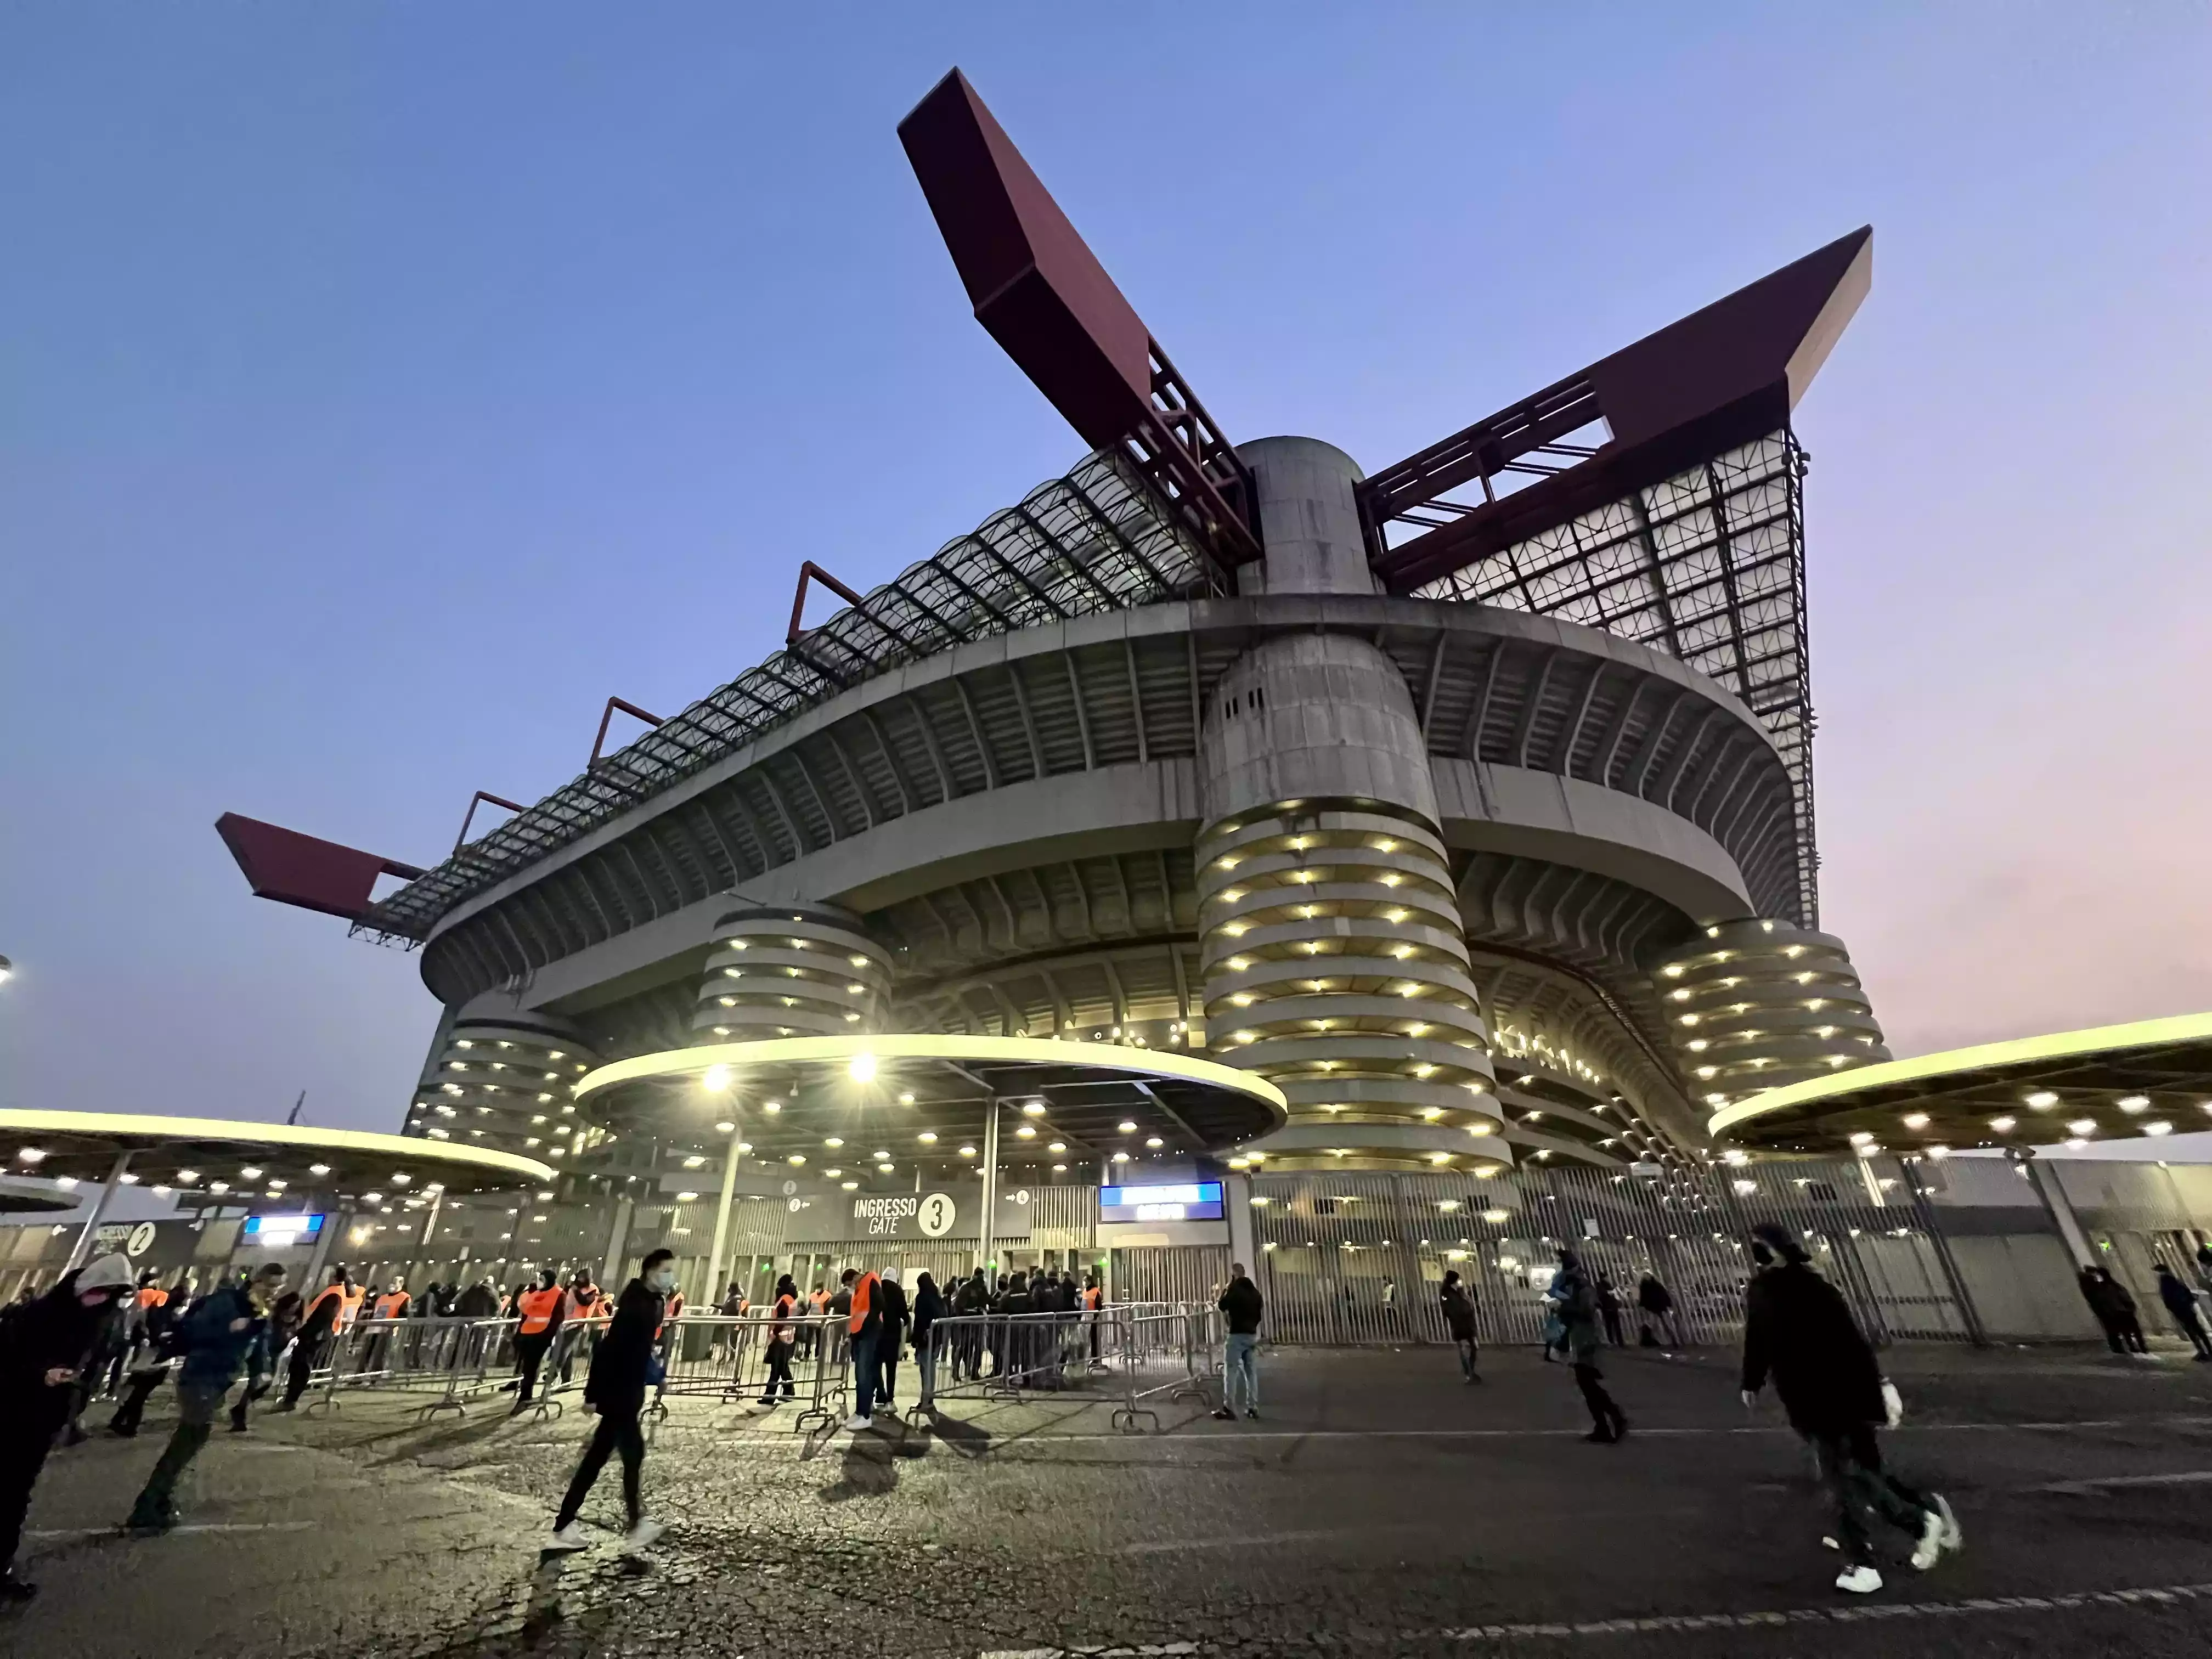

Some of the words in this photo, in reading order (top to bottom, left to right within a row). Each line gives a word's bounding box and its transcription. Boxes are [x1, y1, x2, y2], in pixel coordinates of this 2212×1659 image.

[854, 1198, 917, 1218] INGRESSO
[930, 1199, 943, 1230] 3
[868, 1216, 900, 1234] GATE
[132, 1227, 149, 1251] 2
